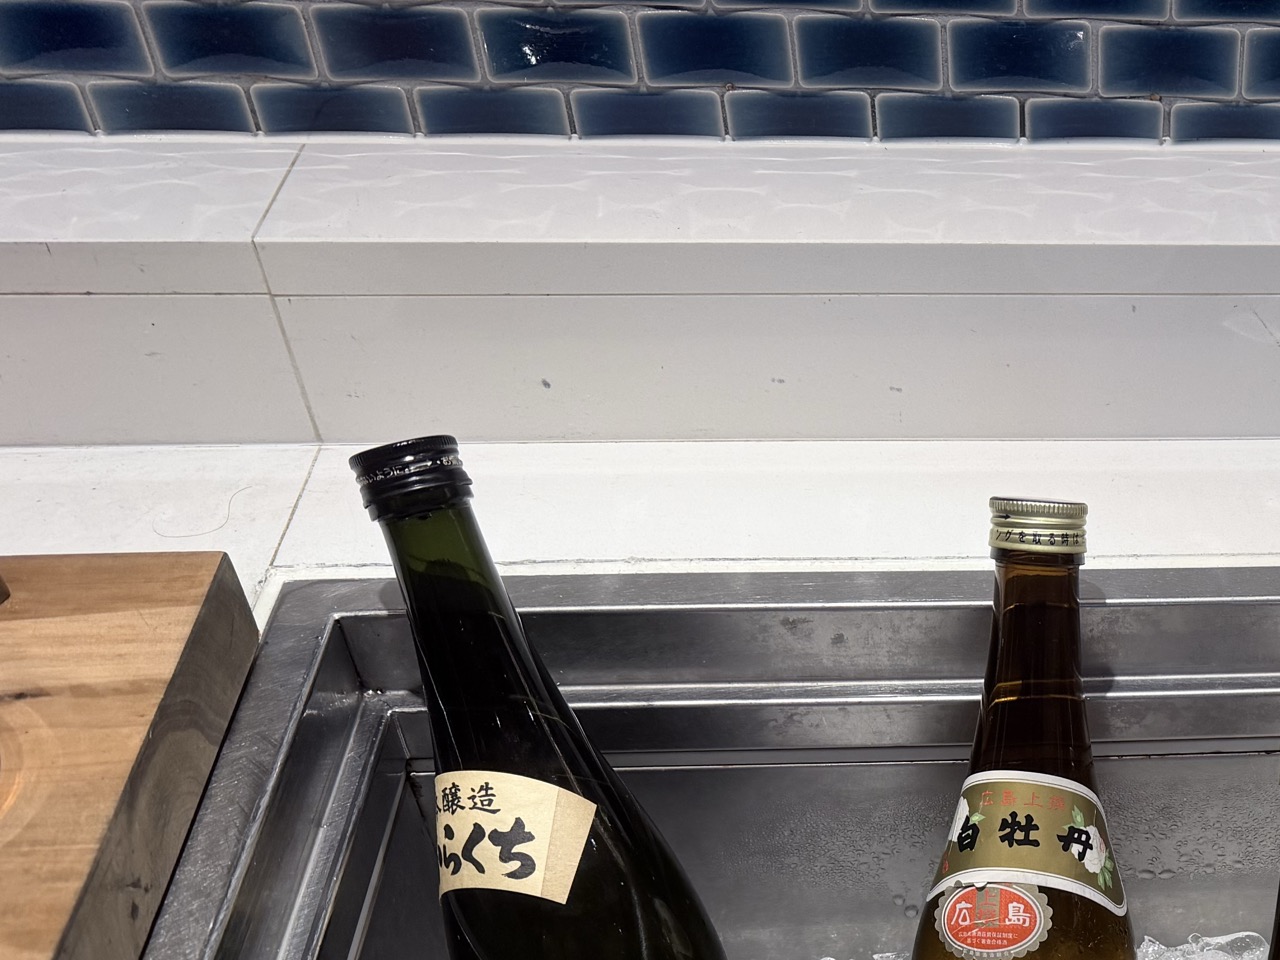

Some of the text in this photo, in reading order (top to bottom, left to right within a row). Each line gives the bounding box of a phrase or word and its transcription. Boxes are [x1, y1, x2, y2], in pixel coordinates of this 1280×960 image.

[436, 782, 501, 815] 醸造
[437, 817, 536, 880] らくち
[957, 811, 1093, 862] 白牡丹
